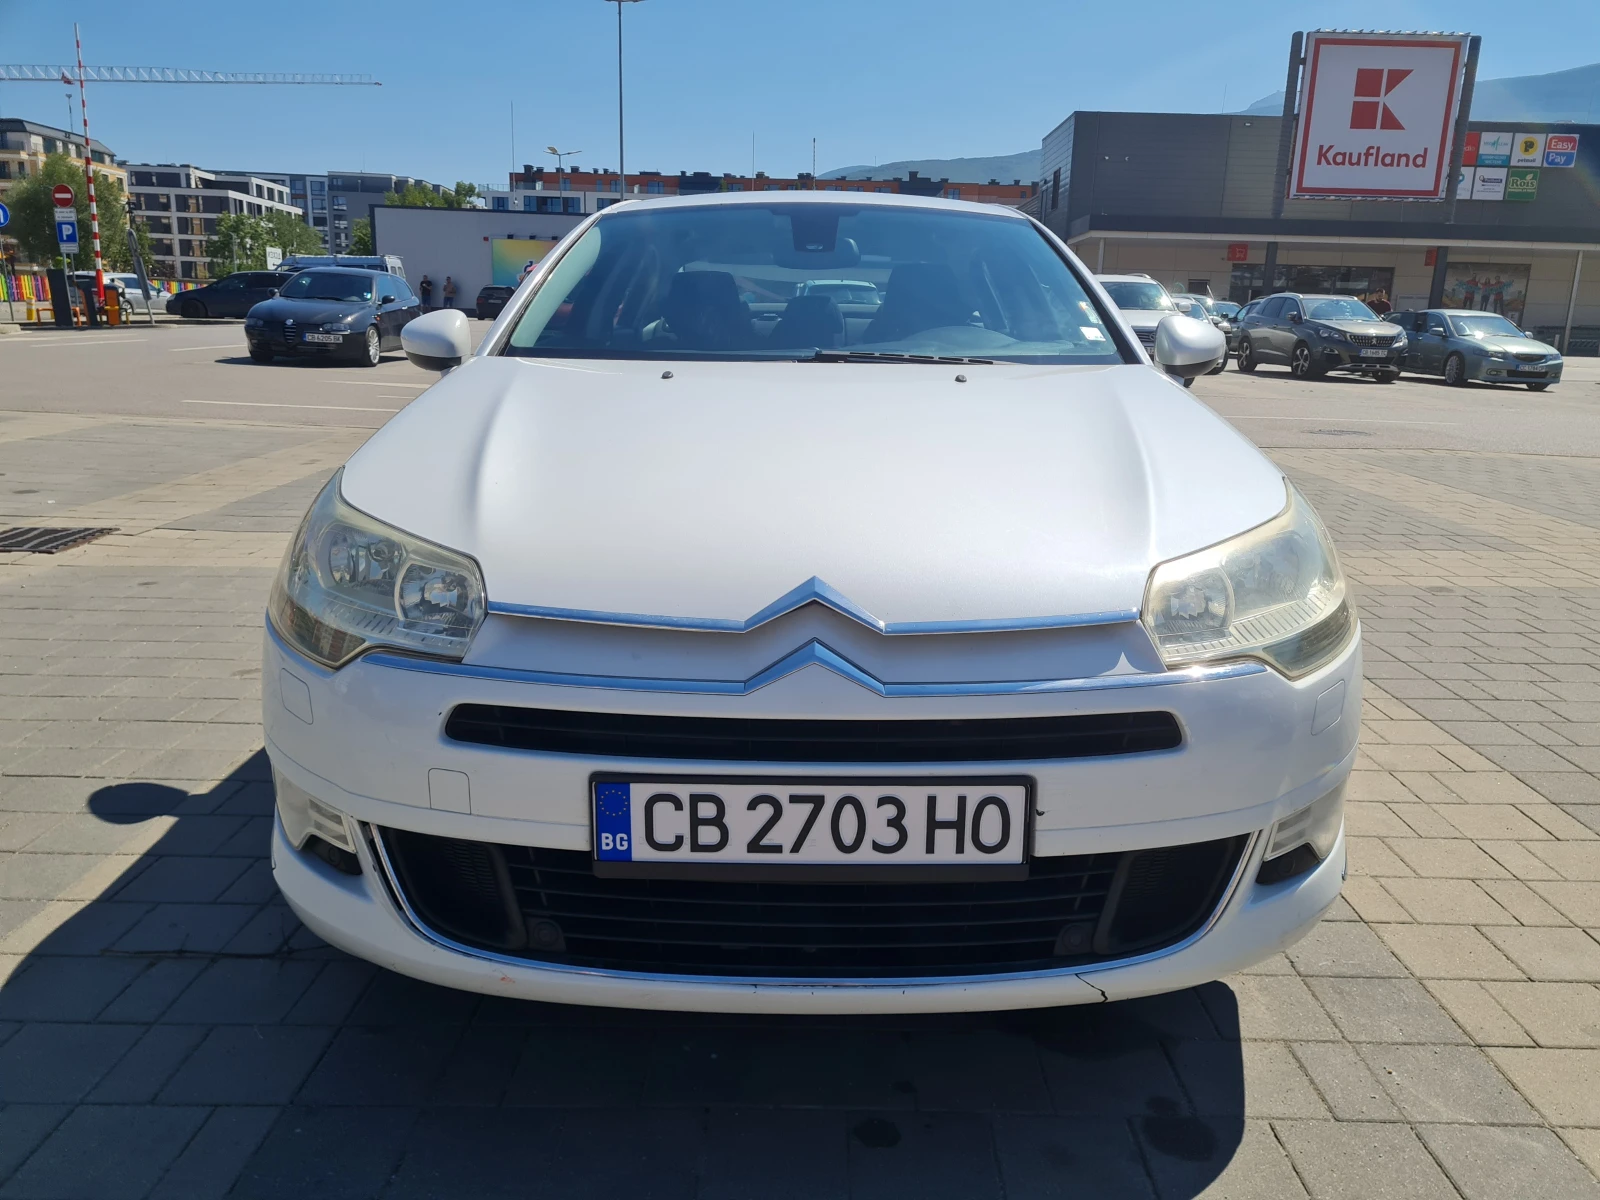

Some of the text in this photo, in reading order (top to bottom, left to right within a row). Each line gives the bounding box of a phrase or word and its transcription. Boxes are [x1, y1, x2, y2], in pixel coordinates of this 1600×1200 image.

[1551, 140, 1574, 151] Easy
[1316, 144, 1428, 168] Kaufland
[1548, 153, 1567, 164] Pay
[1510, 176, 1536, 188] Rois
[61, 224, 73, 240] P
[643, 793, 1011, 854] CB 2703 HO
[601, 833, 629, 851] BG
